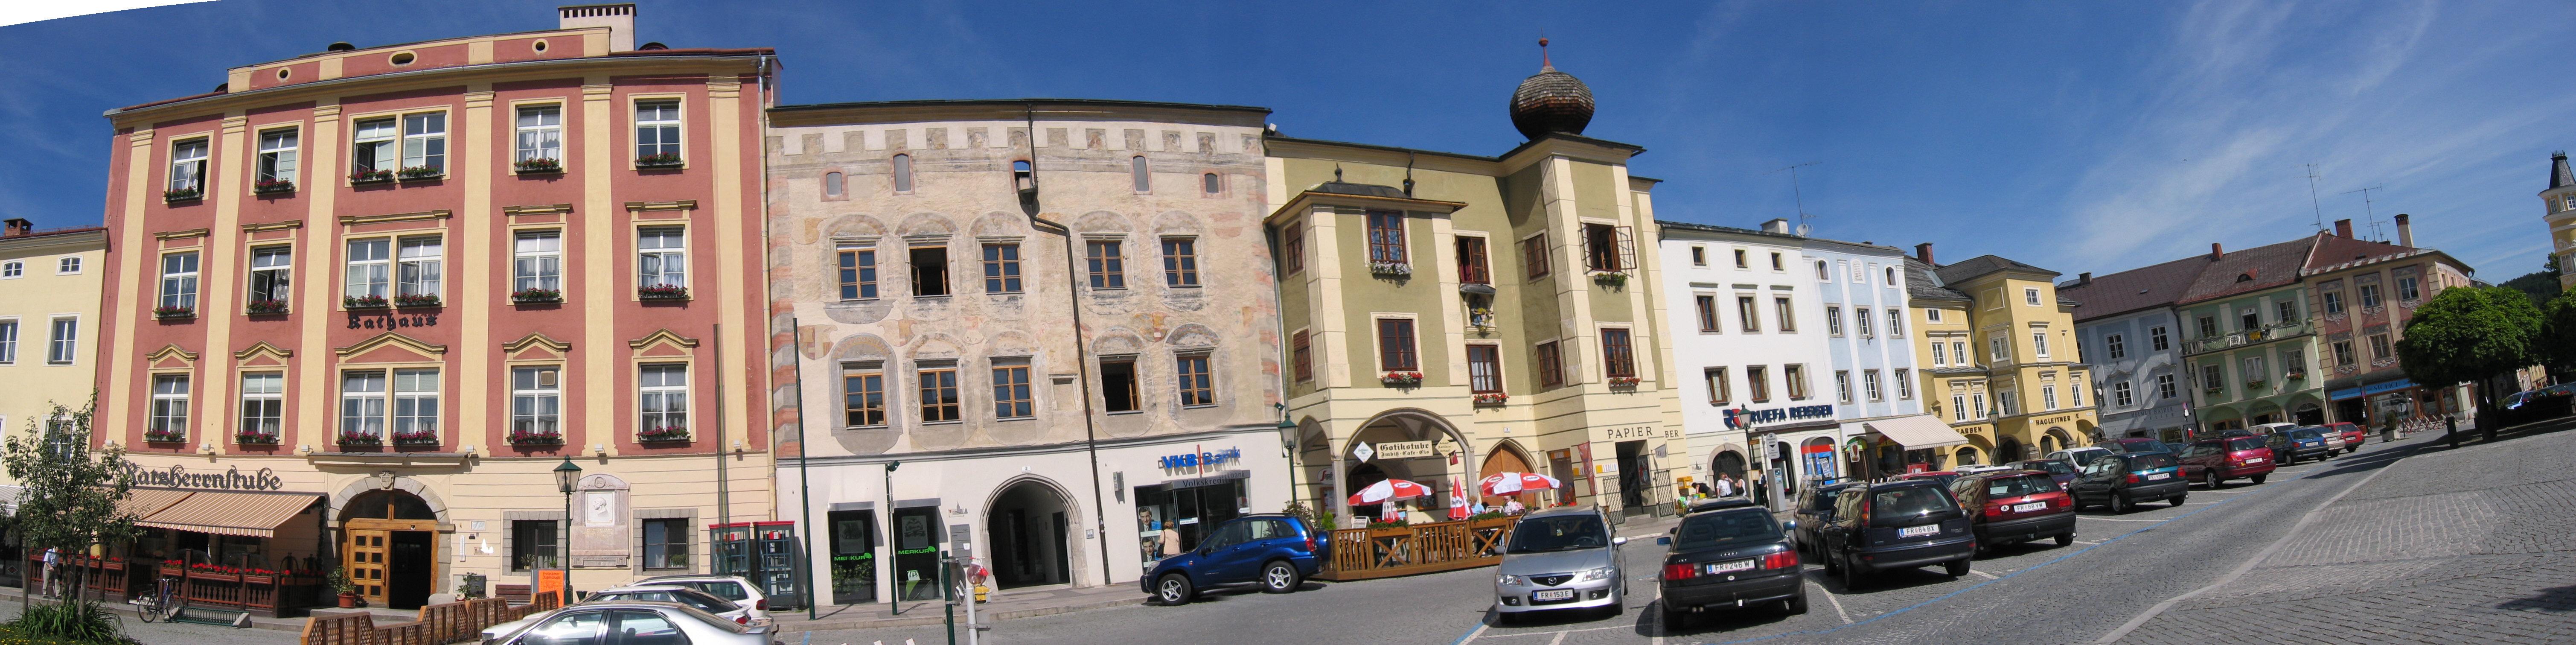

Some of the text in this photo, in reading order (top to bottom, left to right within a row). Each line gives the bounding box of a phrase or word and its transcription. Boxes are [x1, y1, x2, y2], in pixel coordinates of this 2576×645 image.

[347, 313, 437, 331] Rathaus
[1750, 408, 1787, 425] RUEFA
[2035, 416, 2071, 426] HAGLEITNER
[1607, 426, 1653, 439] PAPIER
[1665, 430, 1679, 438] BER
[1380, 443, 1429, 451] Gotikstube
[1161, 453, 1197, 469] VKB
